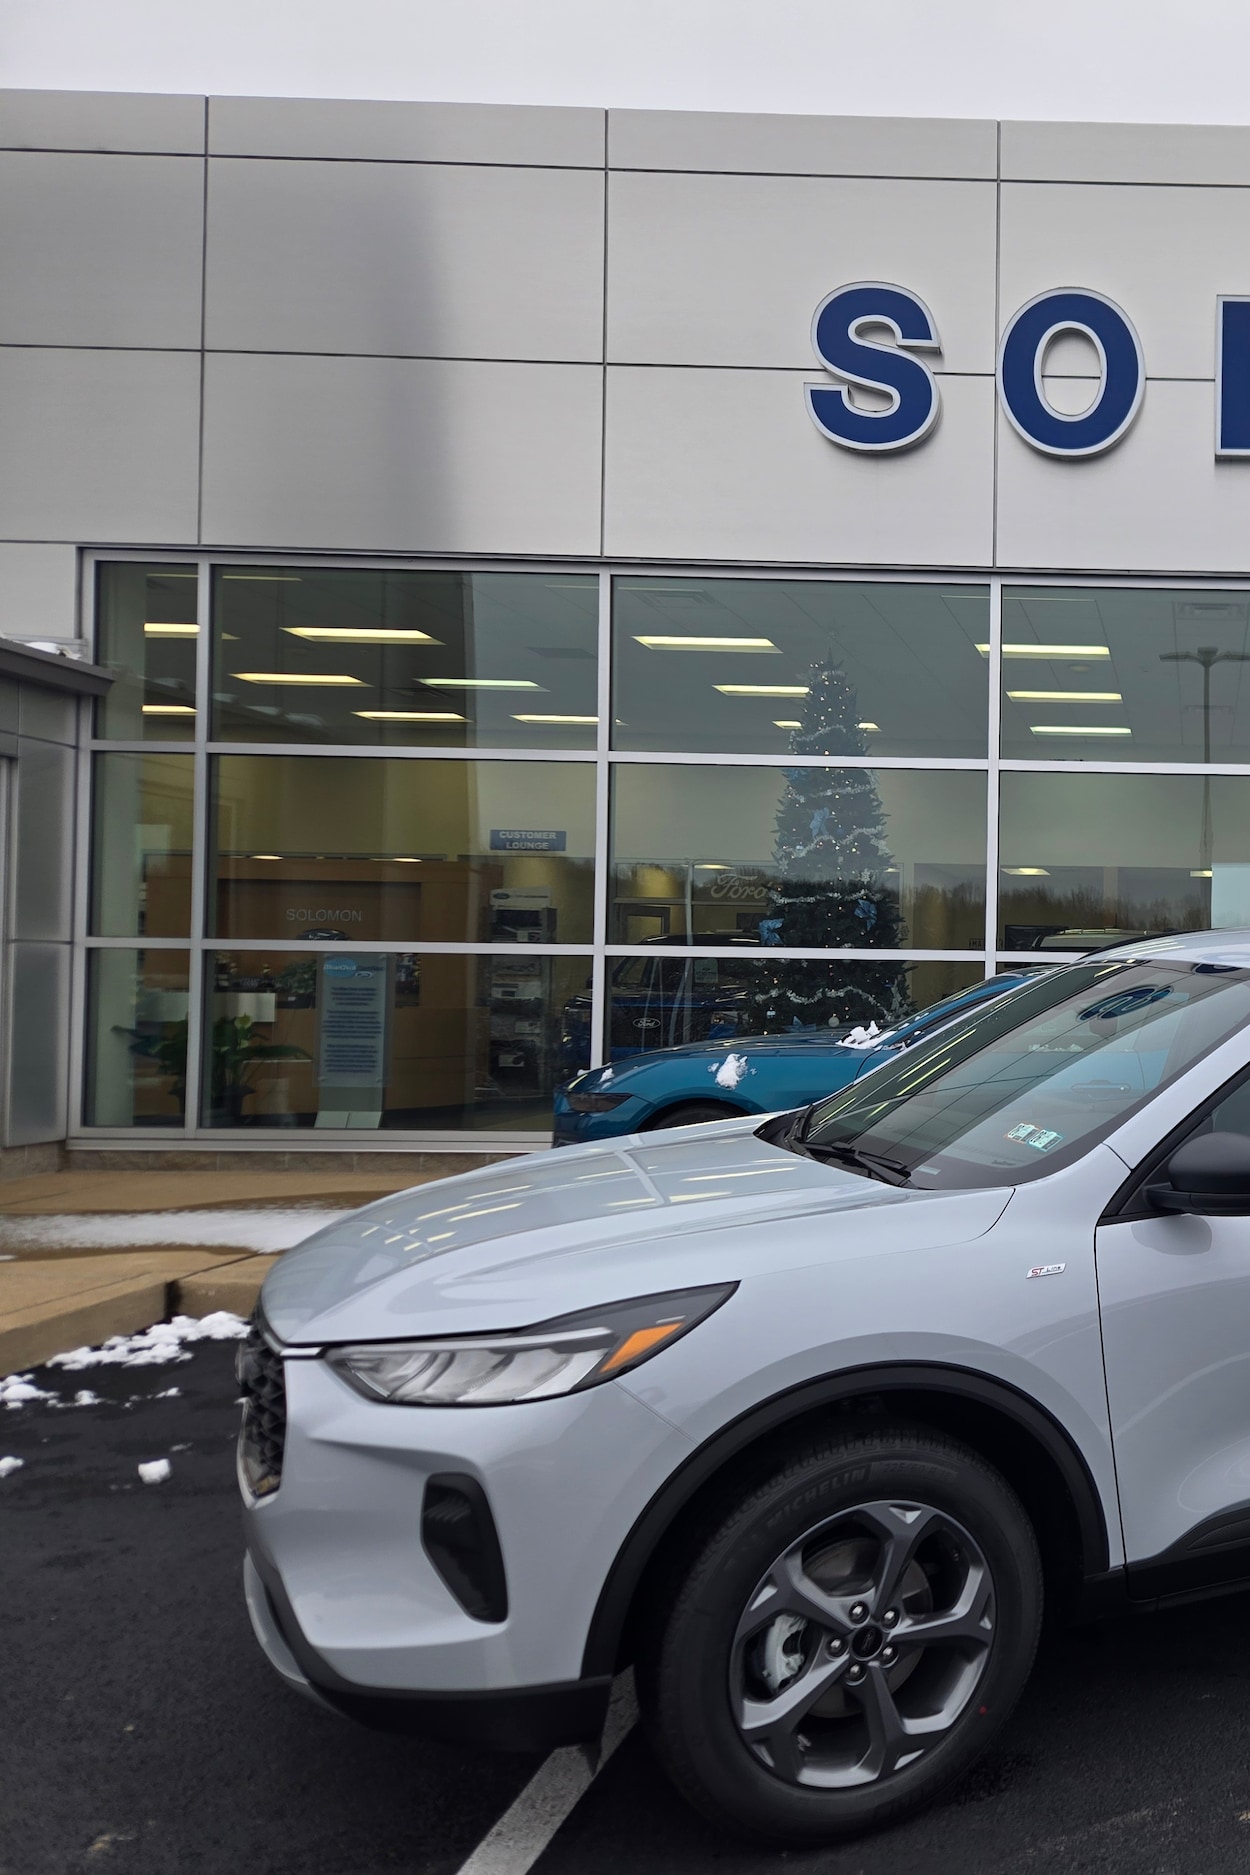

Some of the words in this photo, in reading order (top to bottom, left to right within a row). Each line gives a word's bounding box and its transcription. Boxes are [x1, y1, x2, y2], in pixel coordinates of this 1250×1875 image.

[499, 831, 557, 839] CUSTOMER
[506, 841, 550, 850] LOUNGE
[286, 908, 363, 922] SOLOMON
[766, 1467, 866, 1528] MICHELIN
